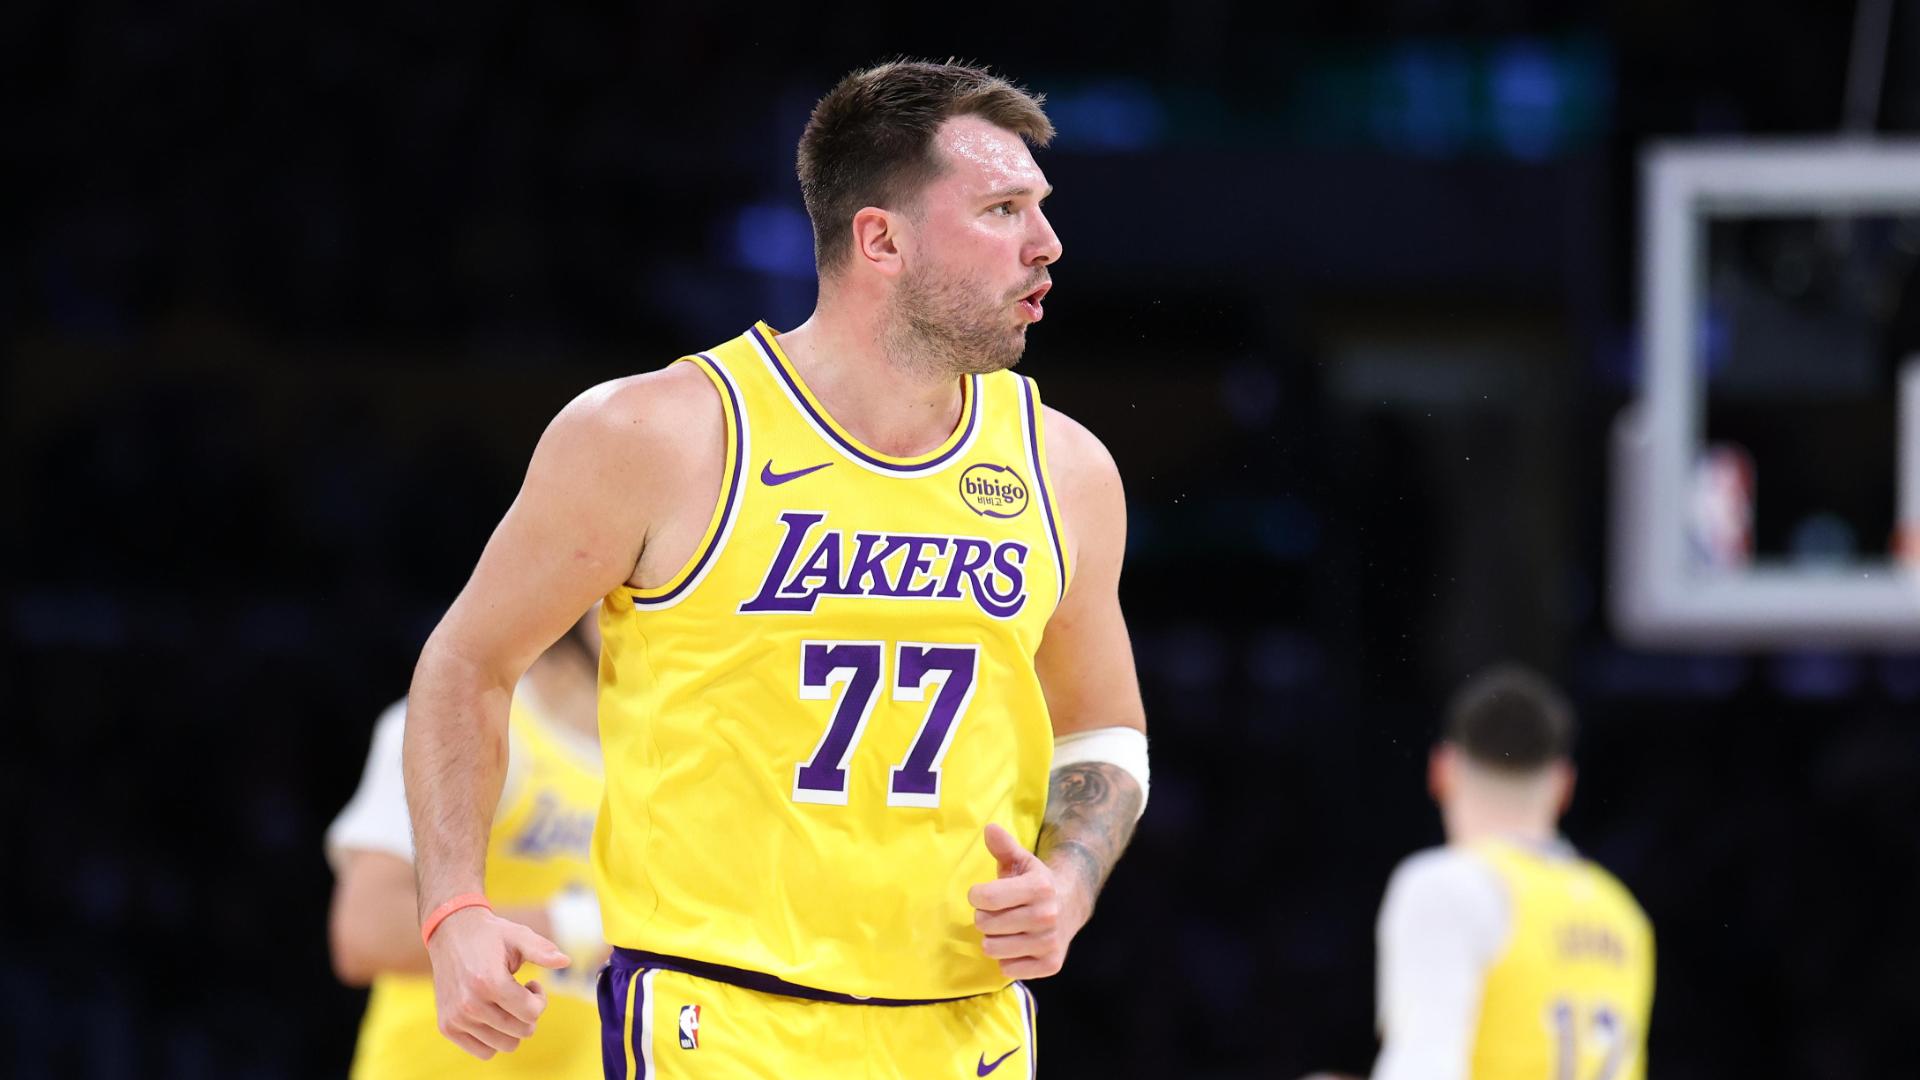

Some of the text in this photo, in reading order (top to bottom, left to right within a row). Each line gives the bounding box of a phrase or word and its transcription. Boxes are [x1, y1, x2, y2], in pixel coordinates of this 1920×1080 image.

[965, 477, 1024, 504] bibigo
[977, 496, 1003, 506] 비비고
[736, 509, 1029, 621] LAKERS
[792, 639, 980, 808] 77
